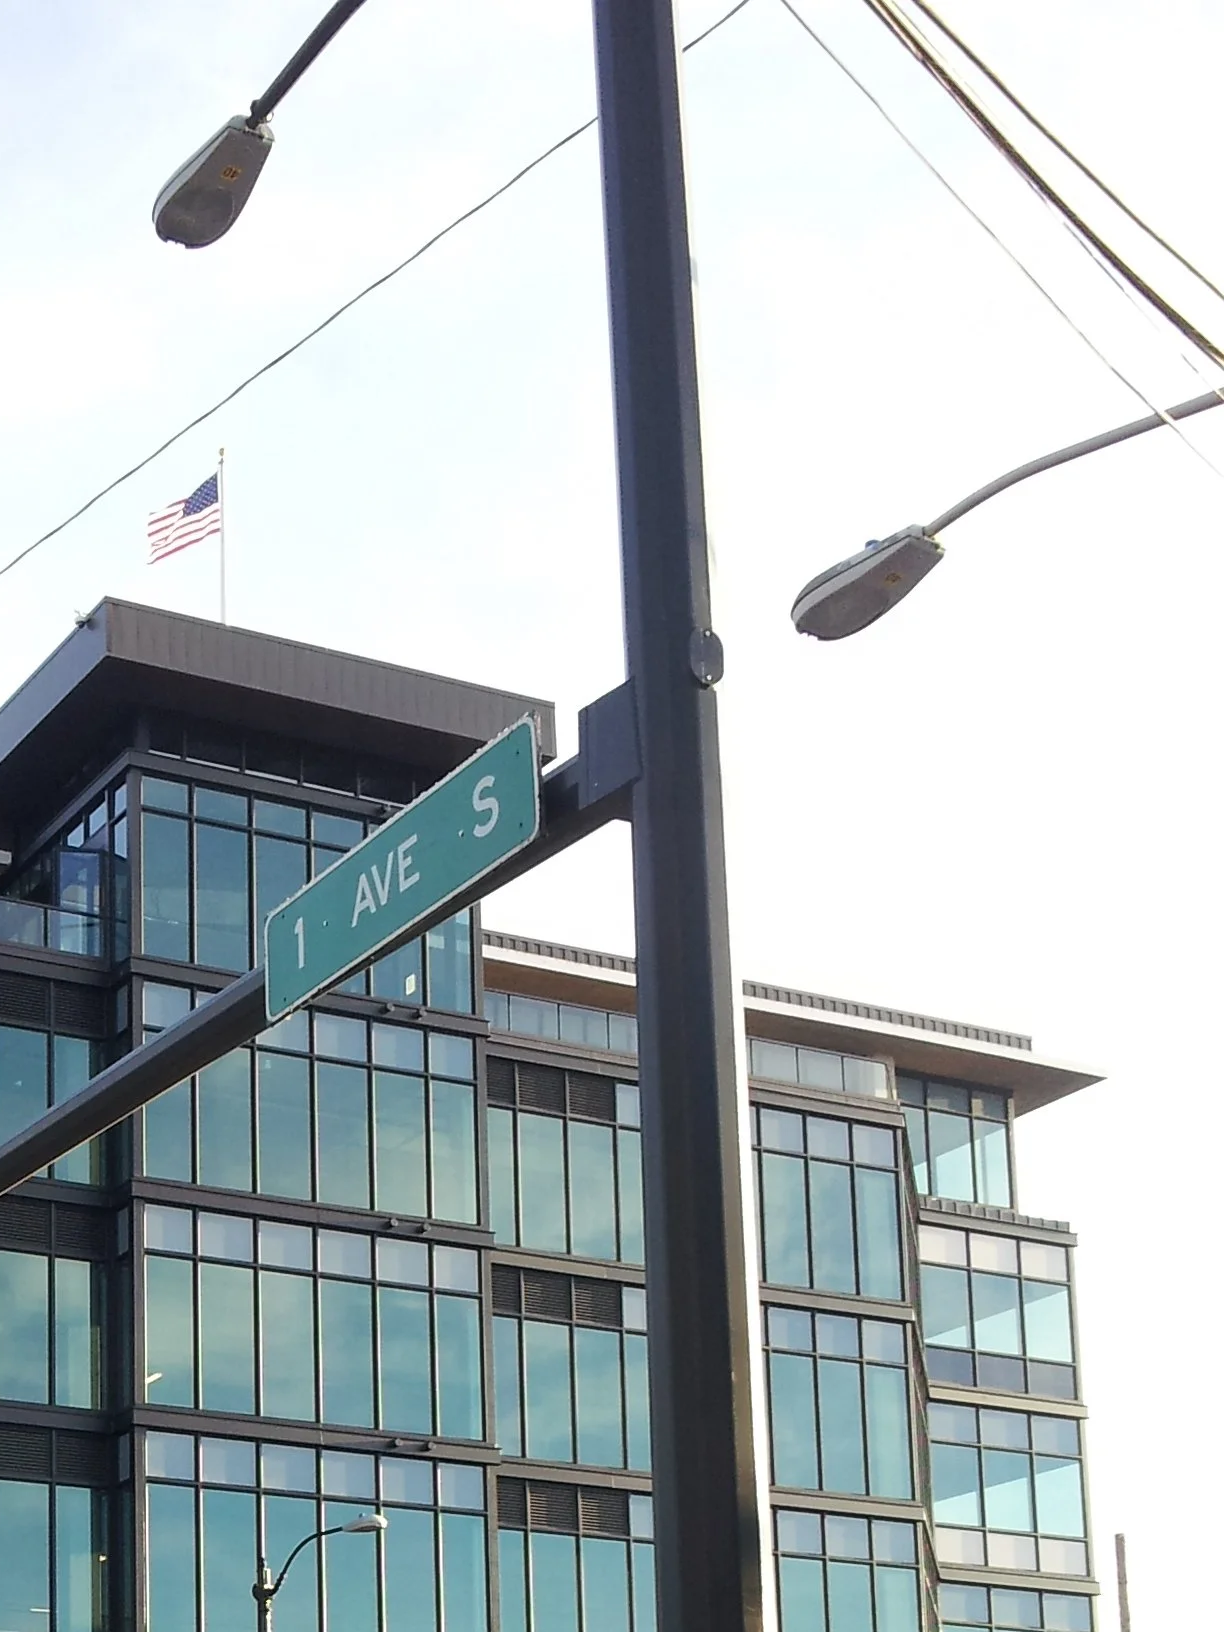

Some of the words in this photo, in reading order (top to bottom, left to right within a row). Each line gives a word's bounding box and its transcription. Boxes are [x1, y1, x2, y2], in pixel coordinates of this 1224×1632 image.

[294, 917, 304, 969] 1
[351, 834, 420, 928] AVE
[472, 775, 499, 838] S
